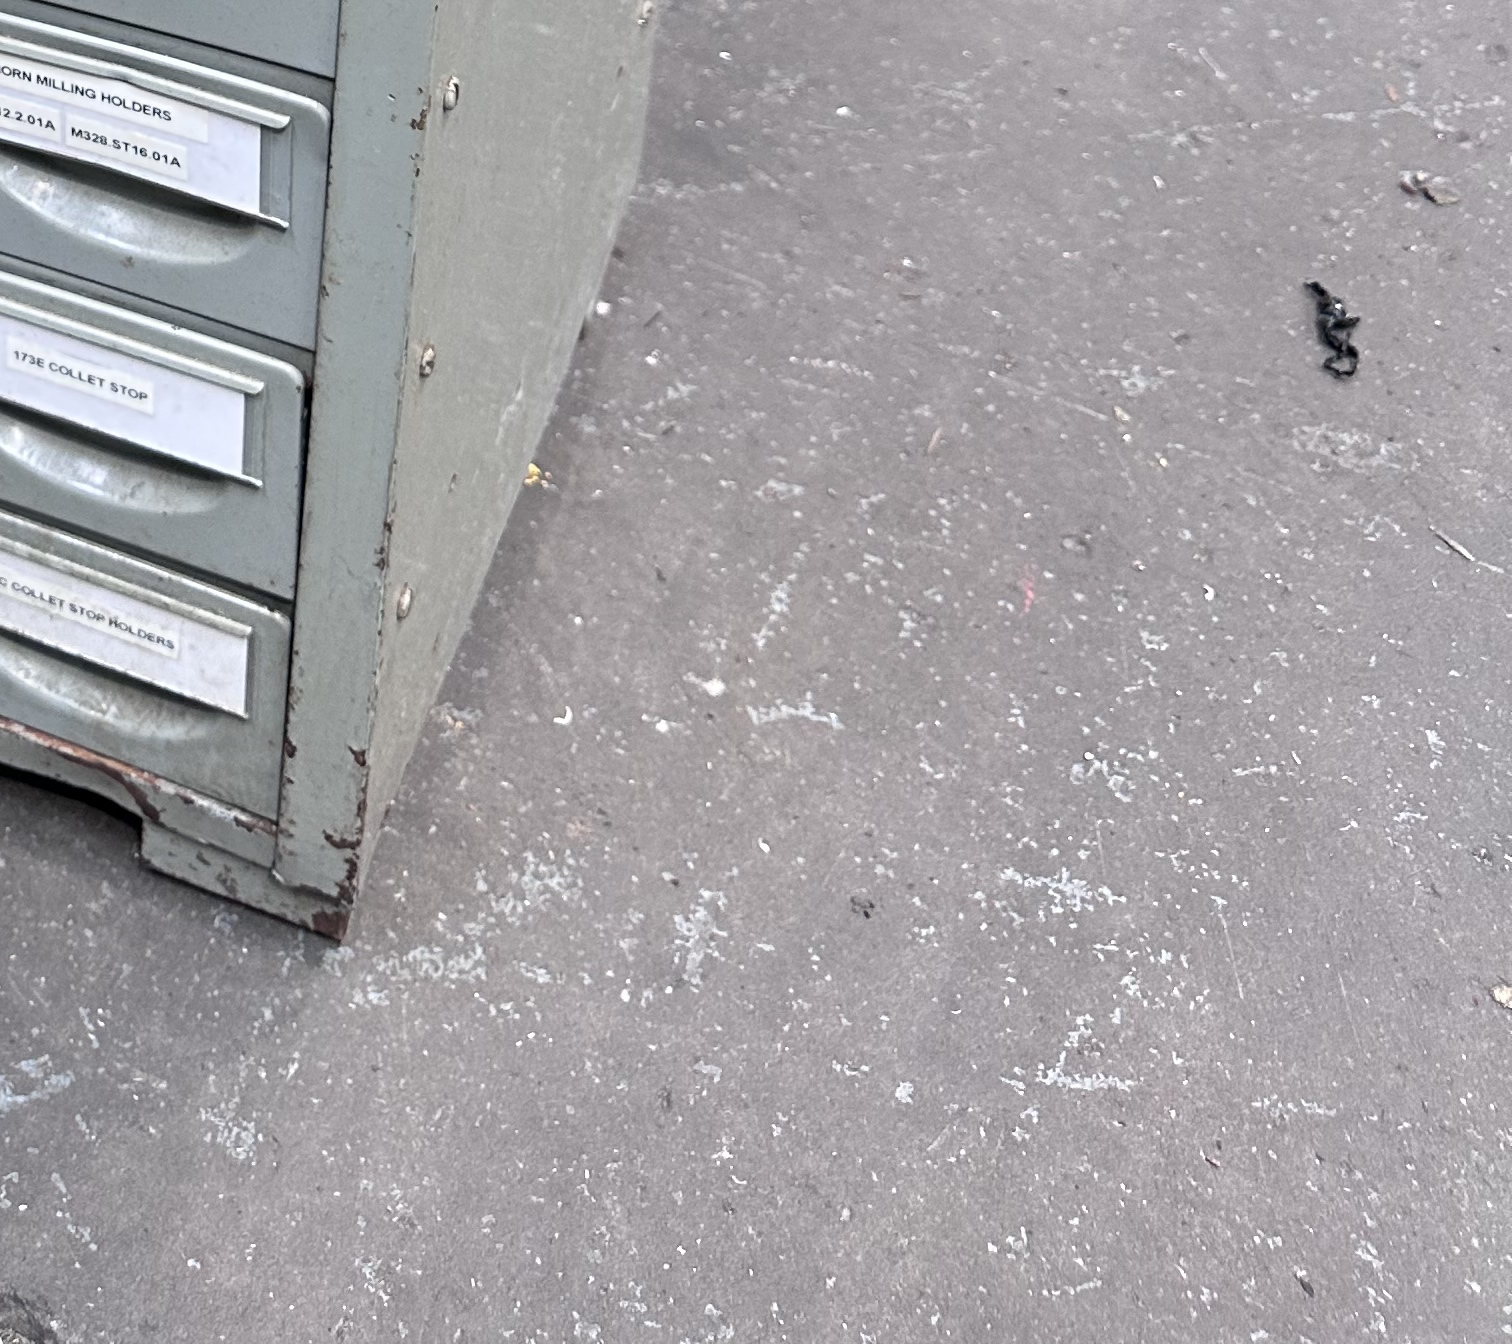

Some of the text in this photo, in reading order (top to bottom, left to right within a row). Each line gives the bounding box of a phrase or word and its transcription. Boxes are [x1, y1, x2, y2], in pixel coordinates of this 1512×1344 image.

[36, 74, 97, 100] MILLING
[101, 92, 172, 122] HOLDERS
[13, 350, 148, 401] 173E COLLET STOP
[11, 581, 66, 610] COLLET
[68, 602, 106, 622] STOP
[108, 616, 175, 650] HOLDERS
